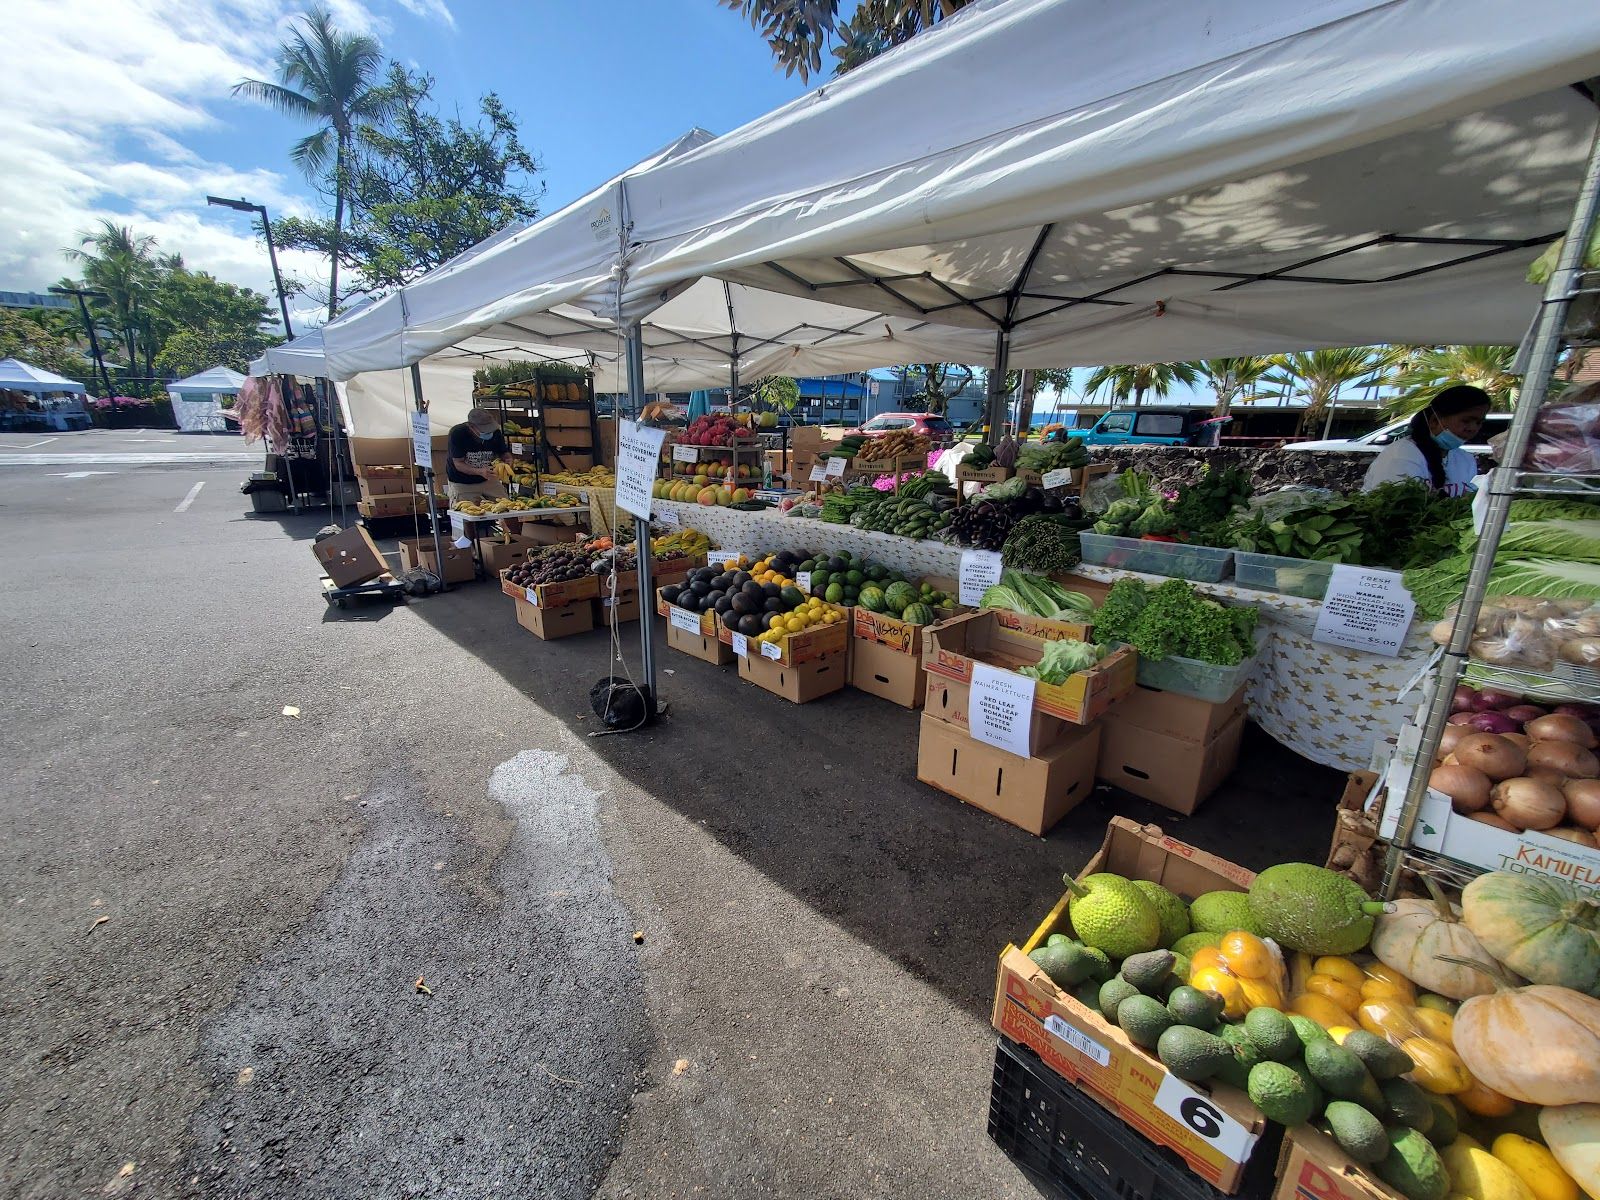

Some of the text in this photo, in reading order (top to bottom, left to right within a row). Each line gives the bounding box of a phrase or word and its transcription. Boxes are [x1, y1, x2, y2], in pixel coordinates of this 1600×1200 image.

[620, 442, 656, 458] FACE COVERING
[640, 441, 655, 450] WEAR
[634, 454, 646, 462] MASK
[626, 476, 642, 486] SOCIAL
[622, 480, 646, 496] DISTANCING
[1359, 581, 1389, 591] LOCAL
[1361, 575, 1391, 584] FRESH
[1330, 602, 1405, 618] BITTERMELON LEAVES
[1356, 601, 1384, 610] POTATO
[1346, 619, 1377, 627] SALUYOT
[1368, 636, 1397, 647] $5.00
[939, 650, 964, 670] Dole
[974, 680, 1030, 700] WAIMEA LETTUCE
[992, 680, 1012, 689] FRESH
[980, 701, 1019, 717] GREEN LEAF
[999, 699, 1015, 709] LEAF
[984, 708, 1013, 721] ROMAINE
[986, 715, 1010, 726] BUTTER
[984, 720, 1012, 733] ICEBERG
[1163, 838, 1194, 858] Dole
[1006, 972, 1064, 1019] Dol
[1004, 1000, 1052, 1041] ROYAL
[1180, 1097, 1225, 1138] 6
